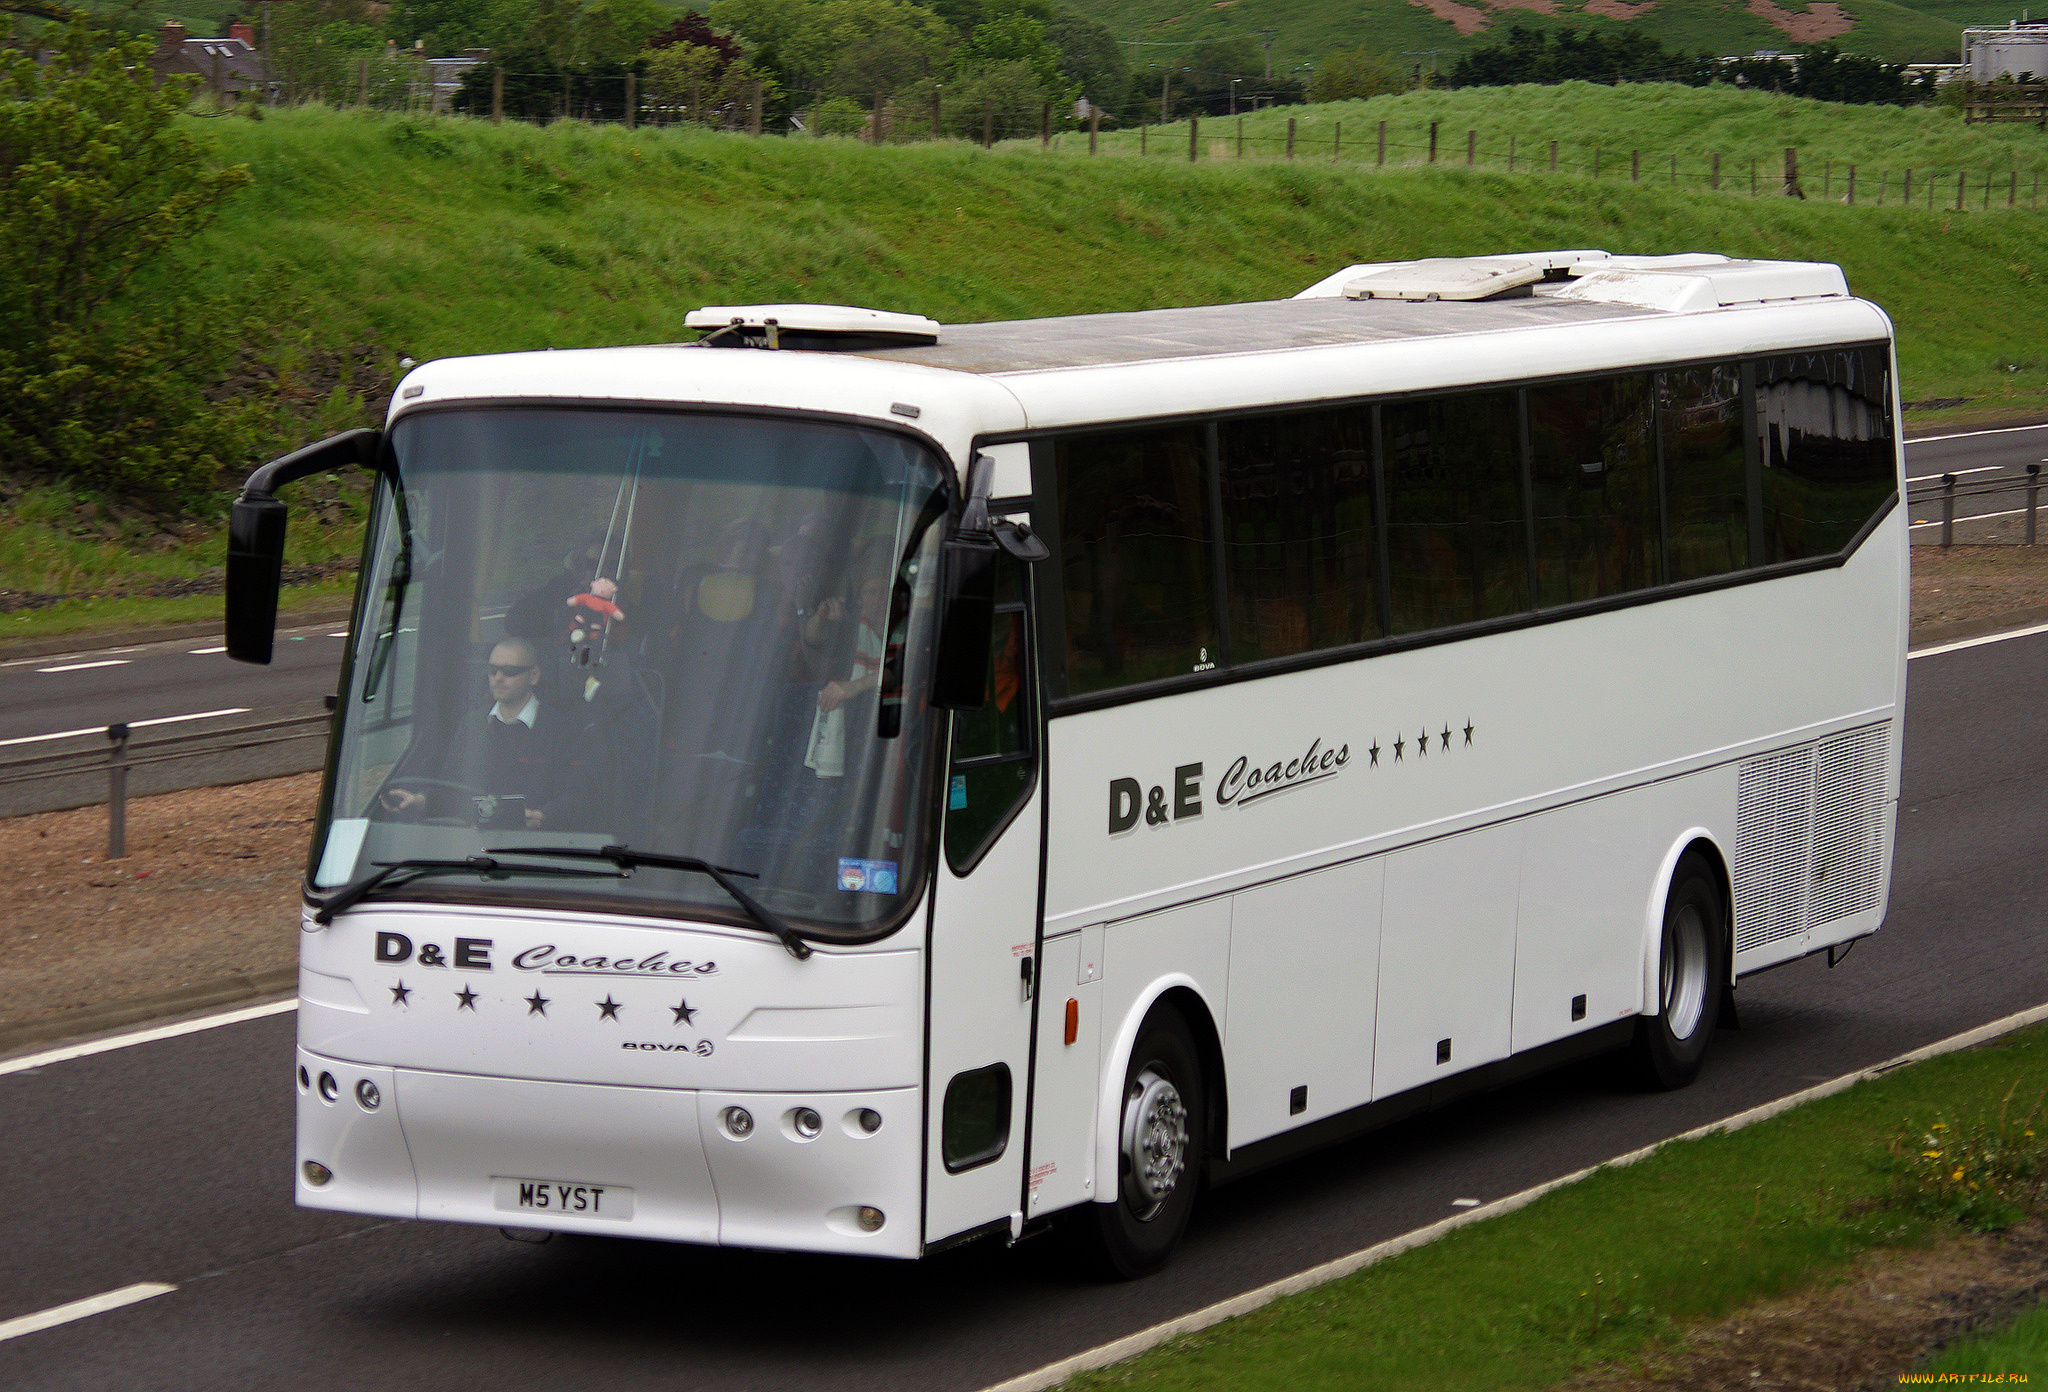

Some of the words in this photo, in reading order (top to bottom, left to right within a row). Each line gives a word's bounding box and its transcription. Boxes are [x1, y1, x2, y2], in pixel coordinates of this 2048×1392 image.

[1193, 661, 1216, 672] BOVA
[1108, 761, 1204, 836] D&E
[1216, 737, 1351, 806] Coaches
[376, 931, 493, 969] D&E
[511, 944, 721, 977] Coaches
[622, 1042, 690, 1053] BOVA
[519, 1182, 550, 1208] M5
[558, 1185, 604, 1213] YST
